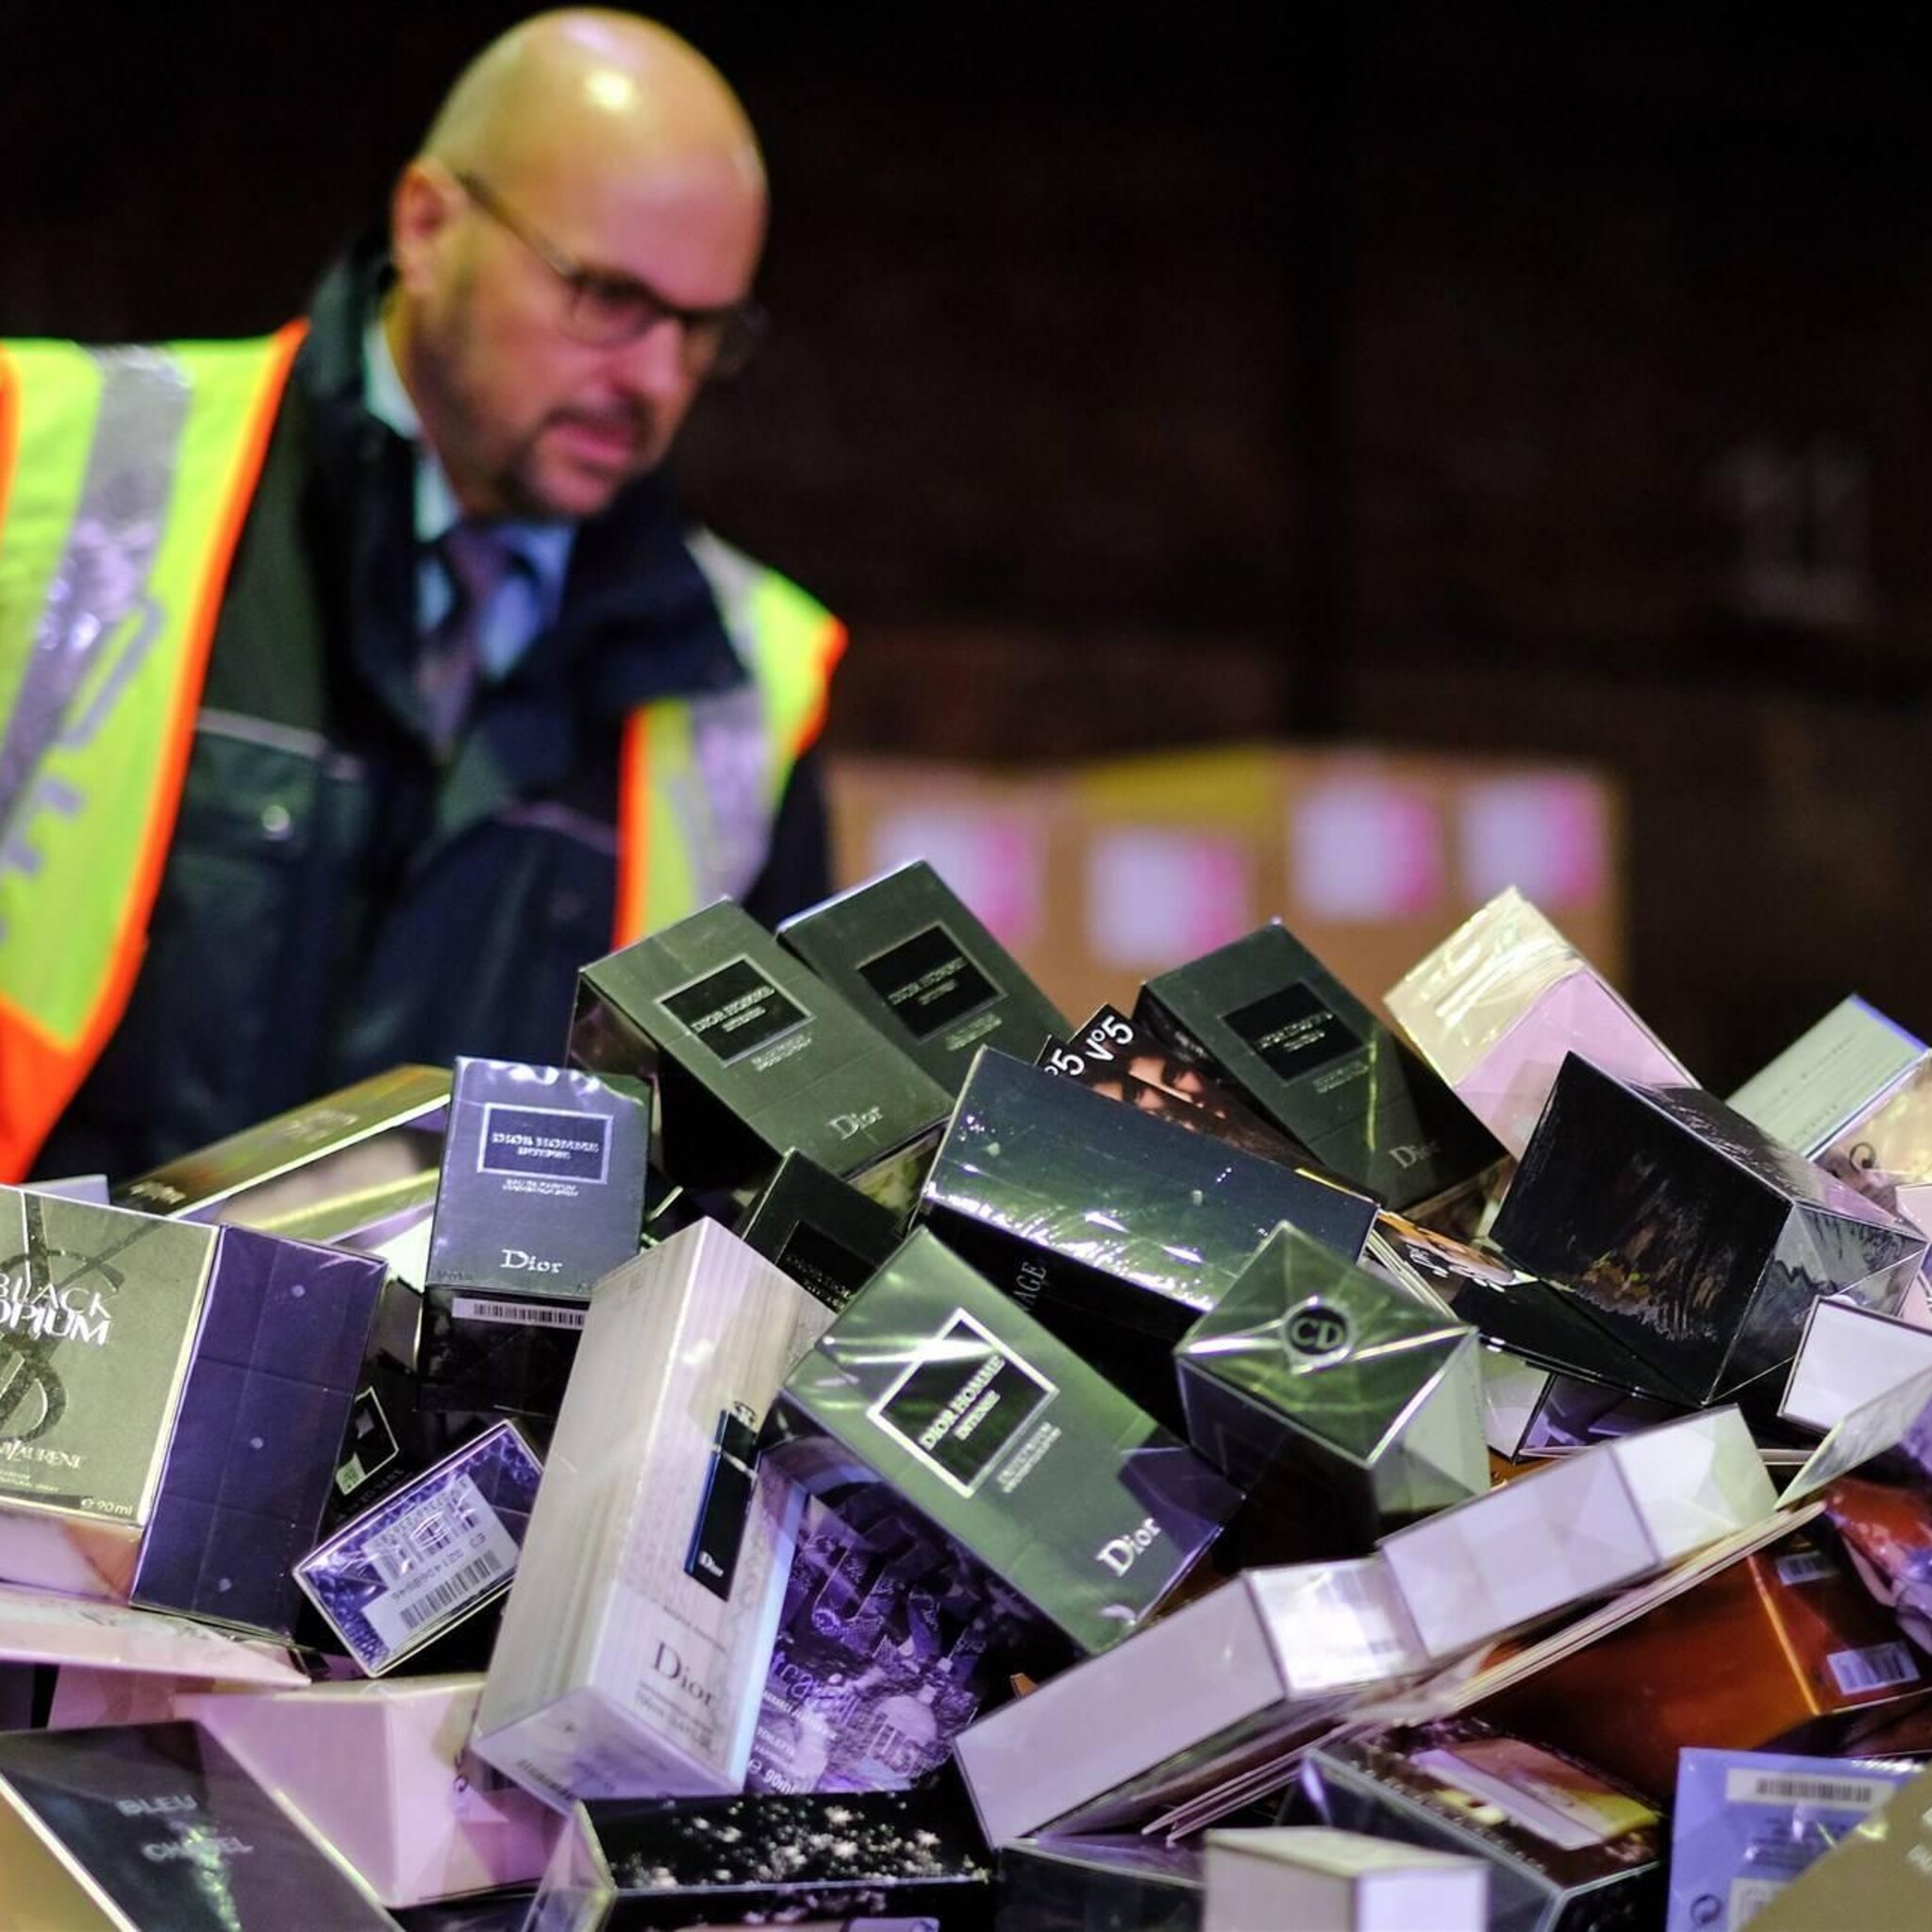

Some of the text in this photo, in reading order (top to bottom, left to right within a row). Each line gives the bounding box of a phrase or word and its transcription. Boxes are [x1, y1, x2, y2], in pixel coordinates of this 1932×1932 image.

[826, 1106, 883, 1141] Dior
[492, 1132, 600, 1153] DIOR HOMME
[500, 1249, 563, 1274] Dior
[1290, 1318, 1345, 1350] CD
[918, 1355, 1006, 1452] DIOR HOMME
[1095, 1517, 1162, 1578] Dior
[653, 1640, 715, 1706] Dior
[115, 1794, 198, 1817] BLEU
